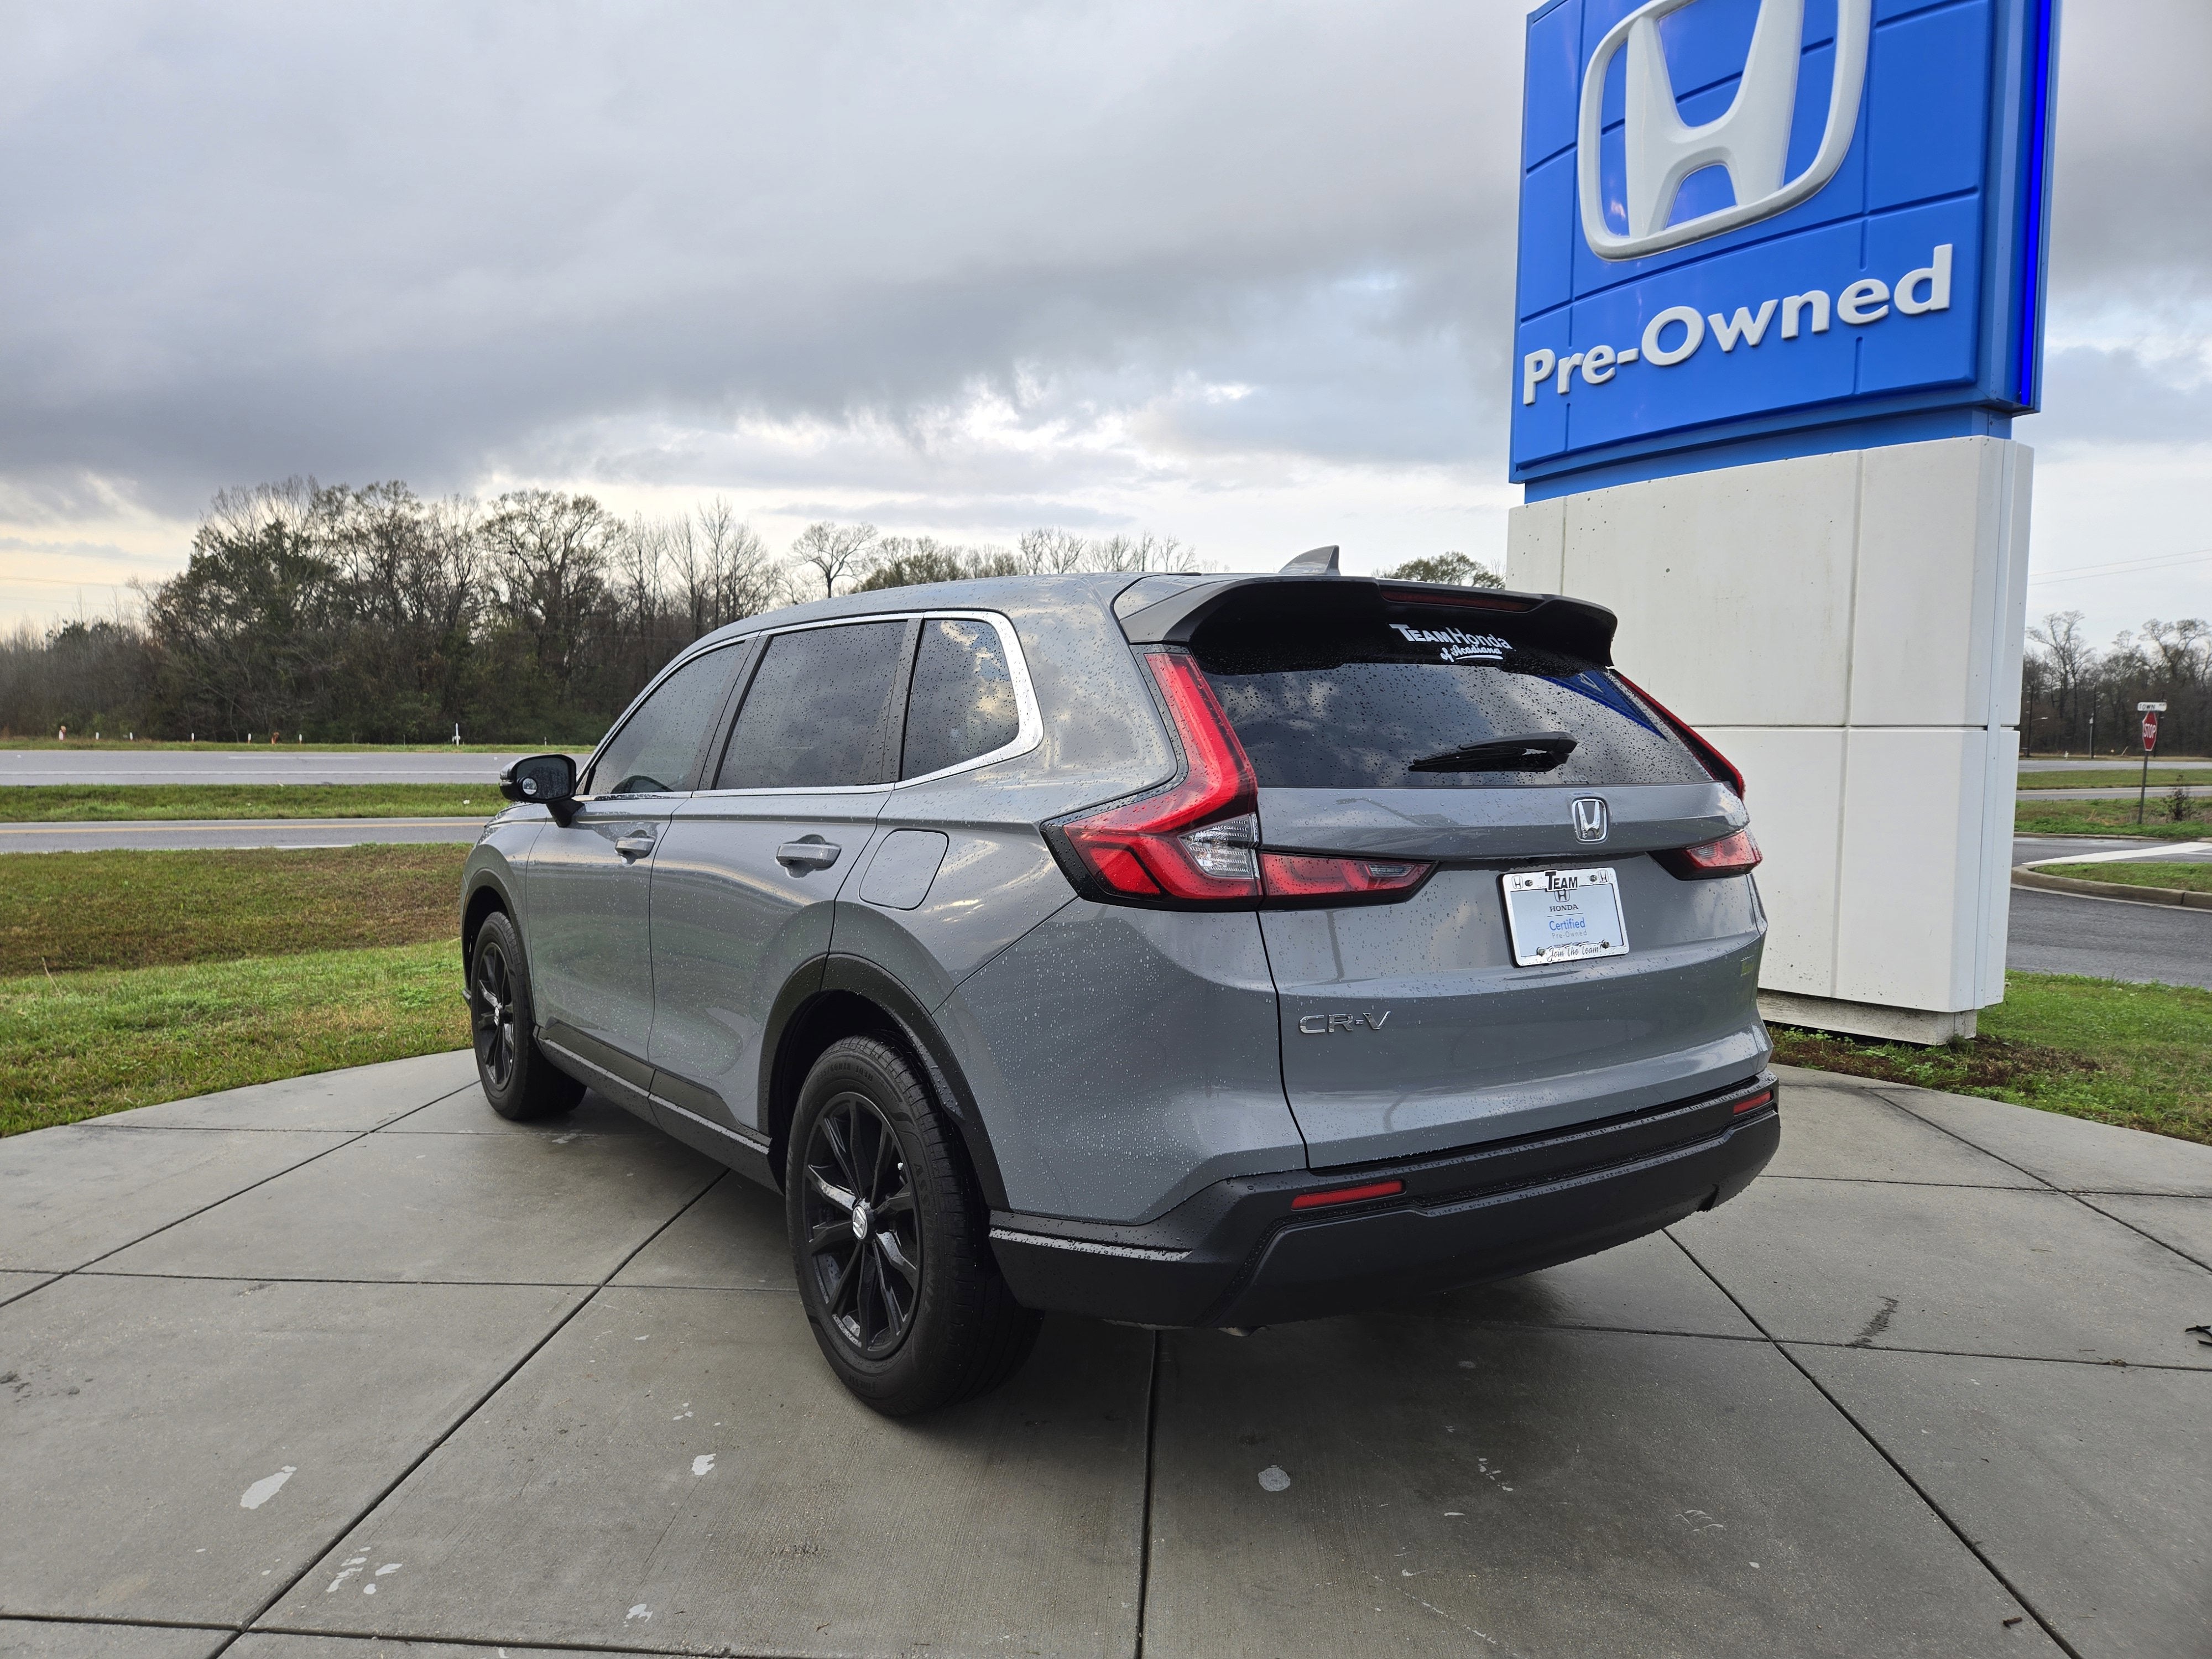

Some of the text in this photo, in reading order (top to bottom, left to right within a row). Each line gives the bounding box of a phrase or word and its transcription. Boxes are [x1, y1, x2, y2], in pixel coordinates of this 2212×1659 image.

[1523, 243, 1953, 405] Pre-Owned
[1445, 627, 1513, 650] Honda
[1440, 647, 1454, 662] of
[2143, 723, 2156, 738] STOP
[1545, 871, 1578, 890] TEAM
[1549, 904, 1579, 912] HONDA
[1549, 917, 1585, 931] Certified
[1552, 931, 1588, 939] Pre-Owned
[1547, 947, 1564, 962] Join
[1564, 945, 1578, 957] The
[1300, 1010, 1391, 1034] CR-V
